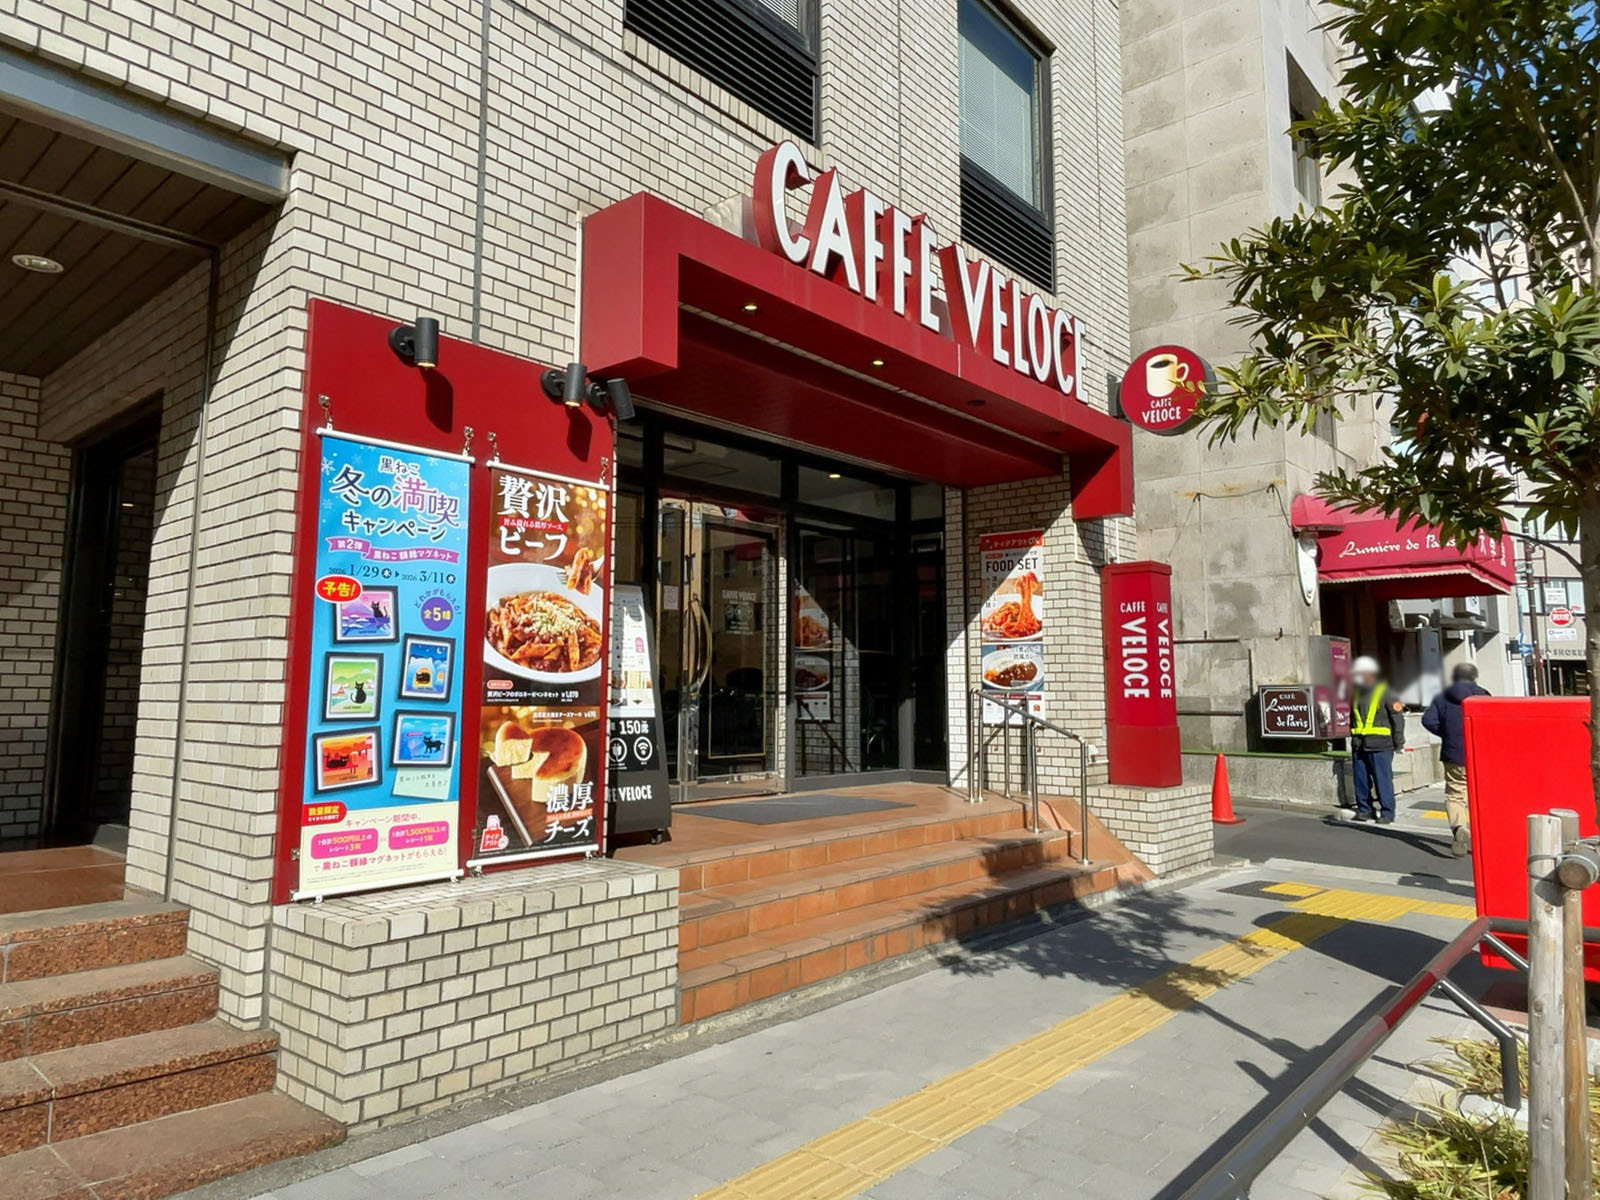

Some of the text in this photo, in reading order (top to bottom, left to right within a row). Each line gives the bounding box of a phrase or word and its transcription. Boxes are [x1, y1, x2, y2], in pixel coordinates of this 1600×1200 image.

[951, 242, 1089, 405] VELOCE
[1141, 406, 1181, 424] VELOCE
[379, 457, 420, 475] 黒ねこ
[331, 466, 459, 528] 冬の満喫
[496, 474, 569, 523] 贅沢
[343, 510, 446, 541] キャンペーン
[498, 525, 568, 561] ビーフ
[1406, 539, 1420, 550] de
[1425, 534, 1456, 549] Pais
[350, 564, 379, 578] 1/29
[419, 570, 444, 584] 3/11
[986, 557, 1039, 573] FOOD SET
[1121, 616, 1150, 699] VELOCE
[1157, 618, 1172, 699] VELOCE
[1276, 714, 1308, 728] de Paris
[545, 781, 594, 814] 濃厚
[618, 784, 652, 802] VELOCE
[543, 815, 593, 844] チーズ
